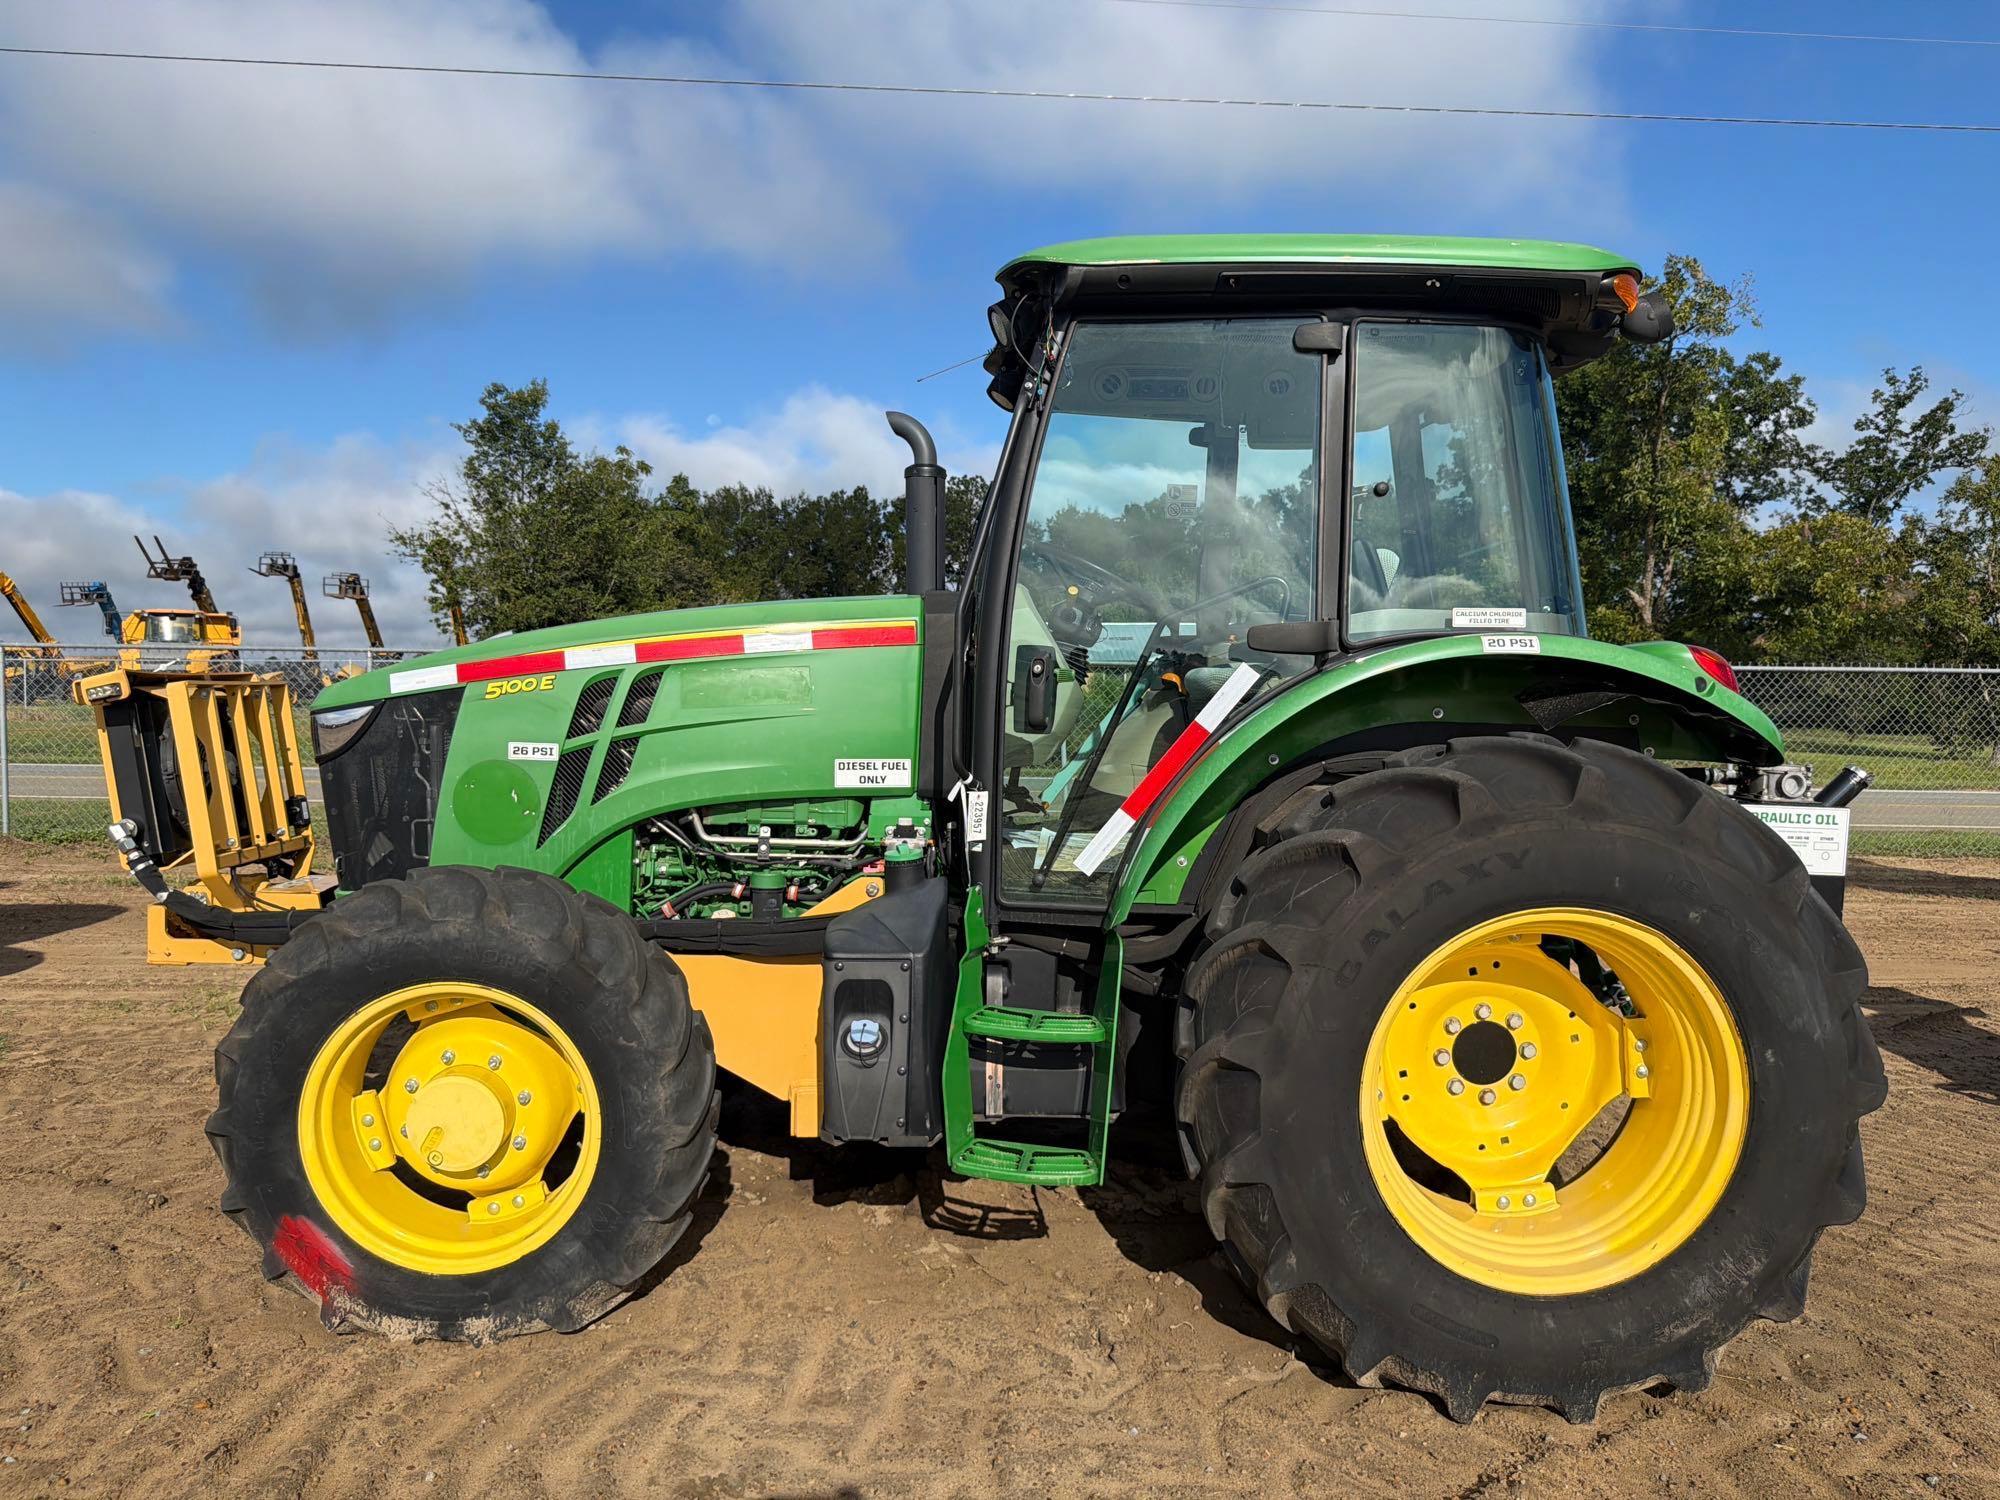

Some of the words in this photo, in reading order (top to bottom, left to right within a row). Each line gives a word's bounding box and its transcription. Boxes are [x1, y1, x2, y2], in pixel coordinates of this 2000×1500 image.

[1487, 638, 1506, 648] 20
[1509, 638, 1535, 648] PSI
[484, 677, 538, 699] 5100
[540, 675, 557, 690] E
[512, 746, 529, 756] 26
[532, 746, 554, 757] PSI
[838, 761, 879, 771] DIESEL
[881, 762, 908, 771] FUEL
[859, 775, 887, 784] ONLY
[973, 801, 984, 834] 223957
[1815, 814, 1839, 826] OIL
